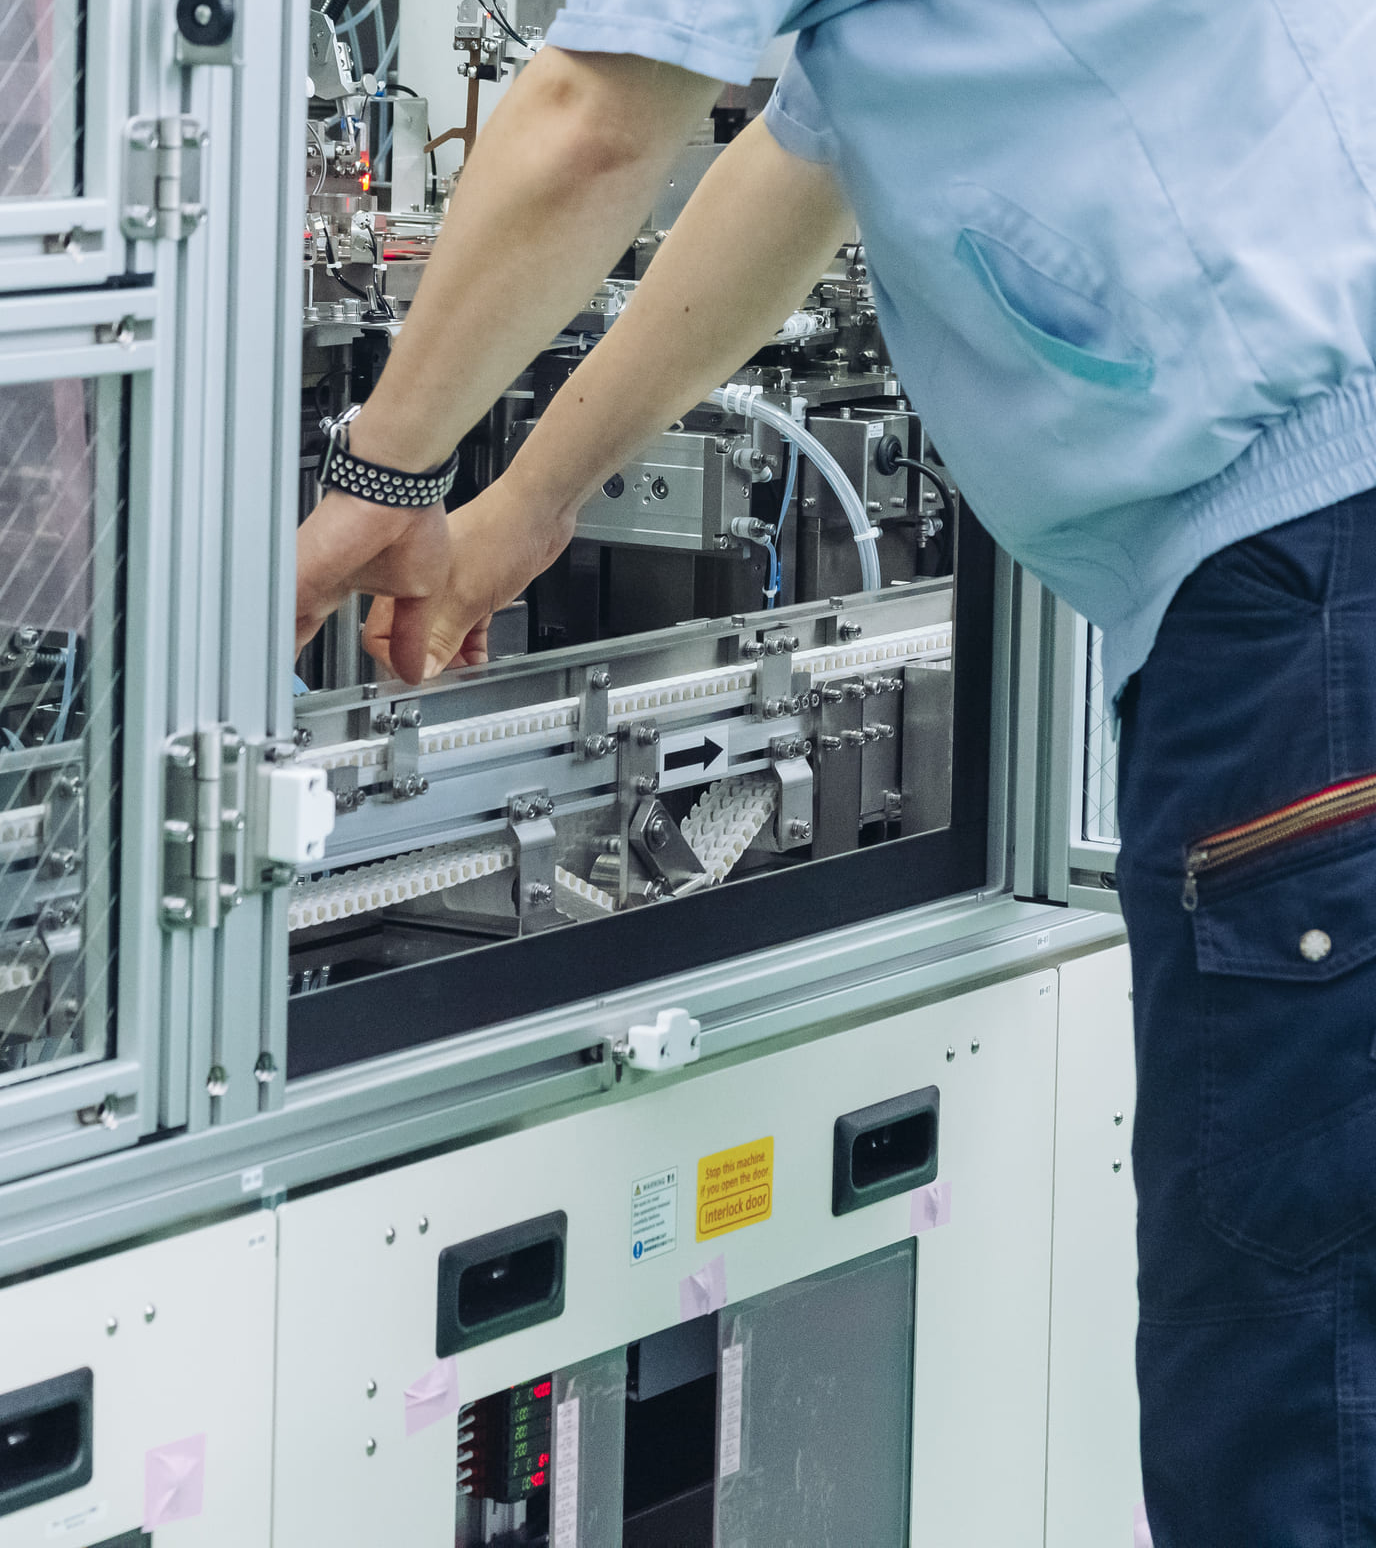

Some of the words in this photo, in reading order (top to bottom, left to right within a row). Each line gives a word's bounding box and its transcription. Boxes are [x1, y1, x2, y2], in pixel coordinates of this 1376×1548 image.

[705, 1167, 721, 1180] Stop
[722, 1160, 735, 1174] this
[736, 1152, 766, 1170] machine
[706, 1183, 720, 1199] you
[721, 1177, 739, 1192] open
[739, 1171, 751, 1185] the
[752, 1166, 769, 1180] door
[705, 1197, 744, 1224] Interlock
[745, 1193, 767, 1211] door
